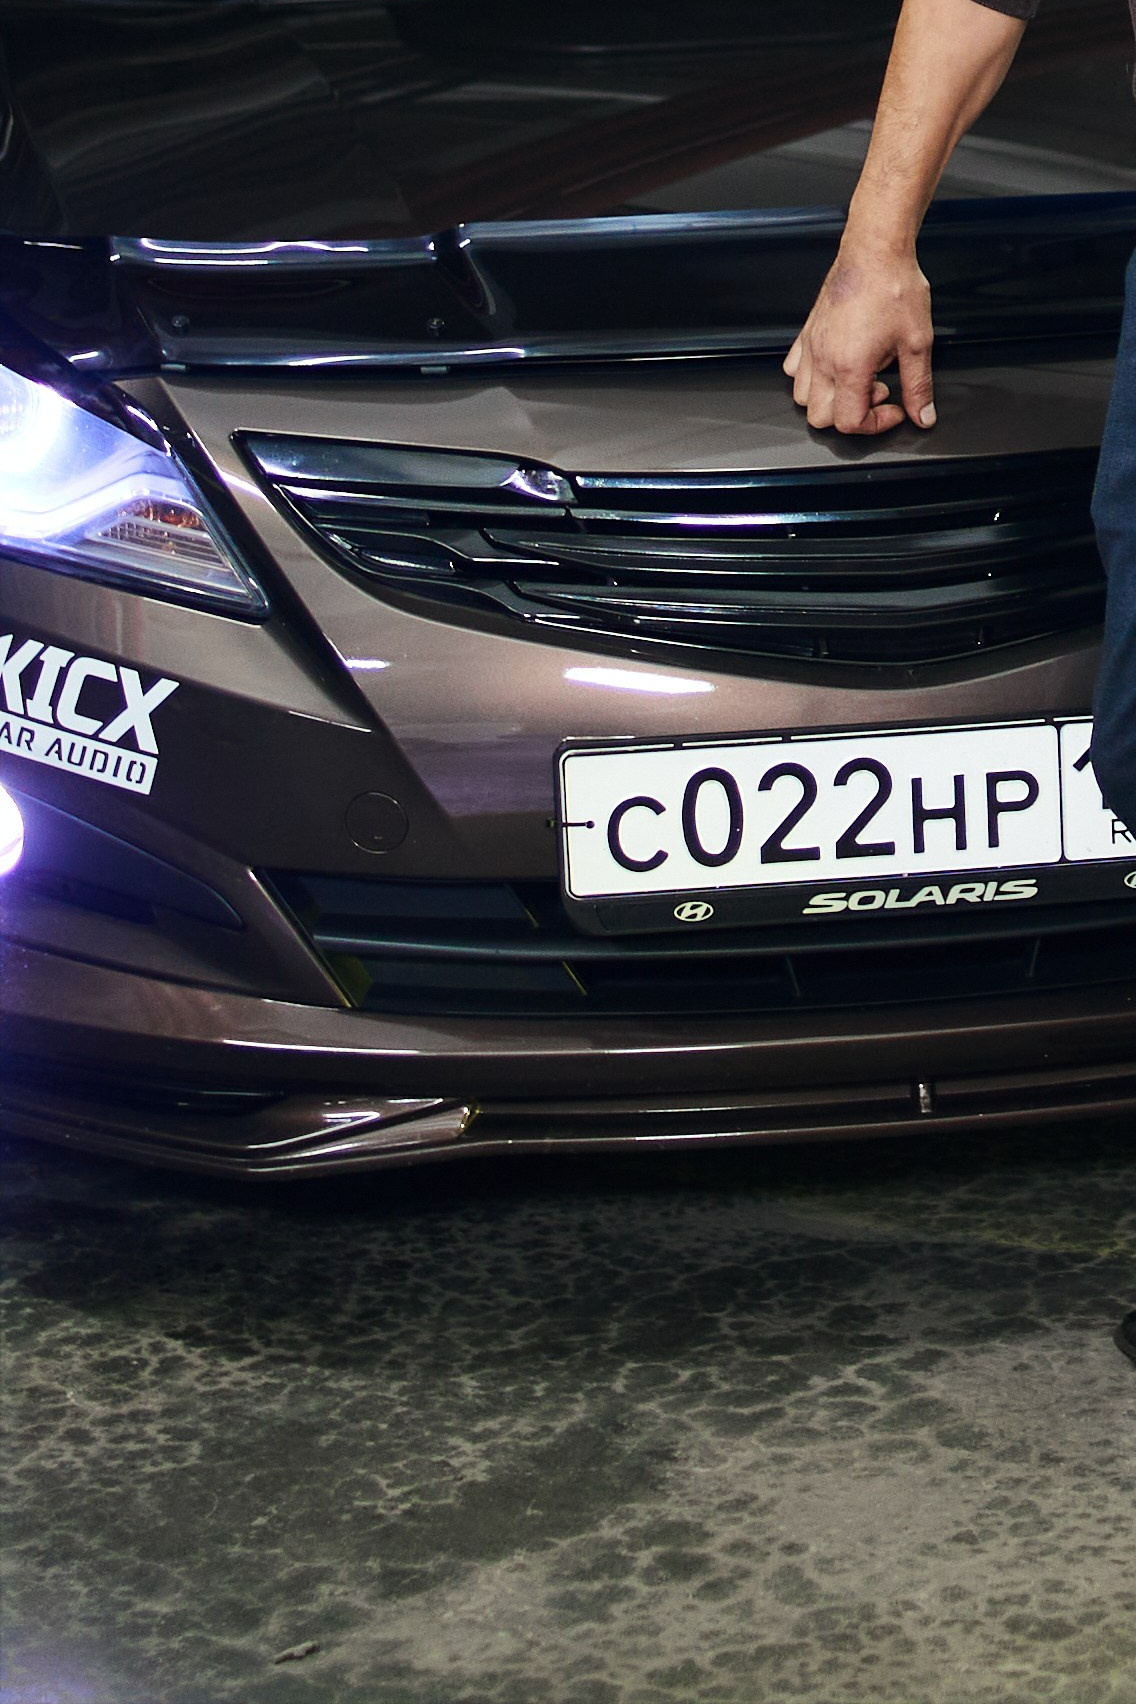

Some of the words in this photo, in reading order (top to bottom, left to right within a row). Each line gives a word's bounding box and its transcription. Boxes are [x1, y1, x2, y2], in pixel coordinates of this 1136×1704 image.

[0, 634, 181, 755] KICX
[0, 721, 35, 751] AR
[44, 737, 147, 785] AUDIO
[802, 878, 1039, 915] SOLARIS
